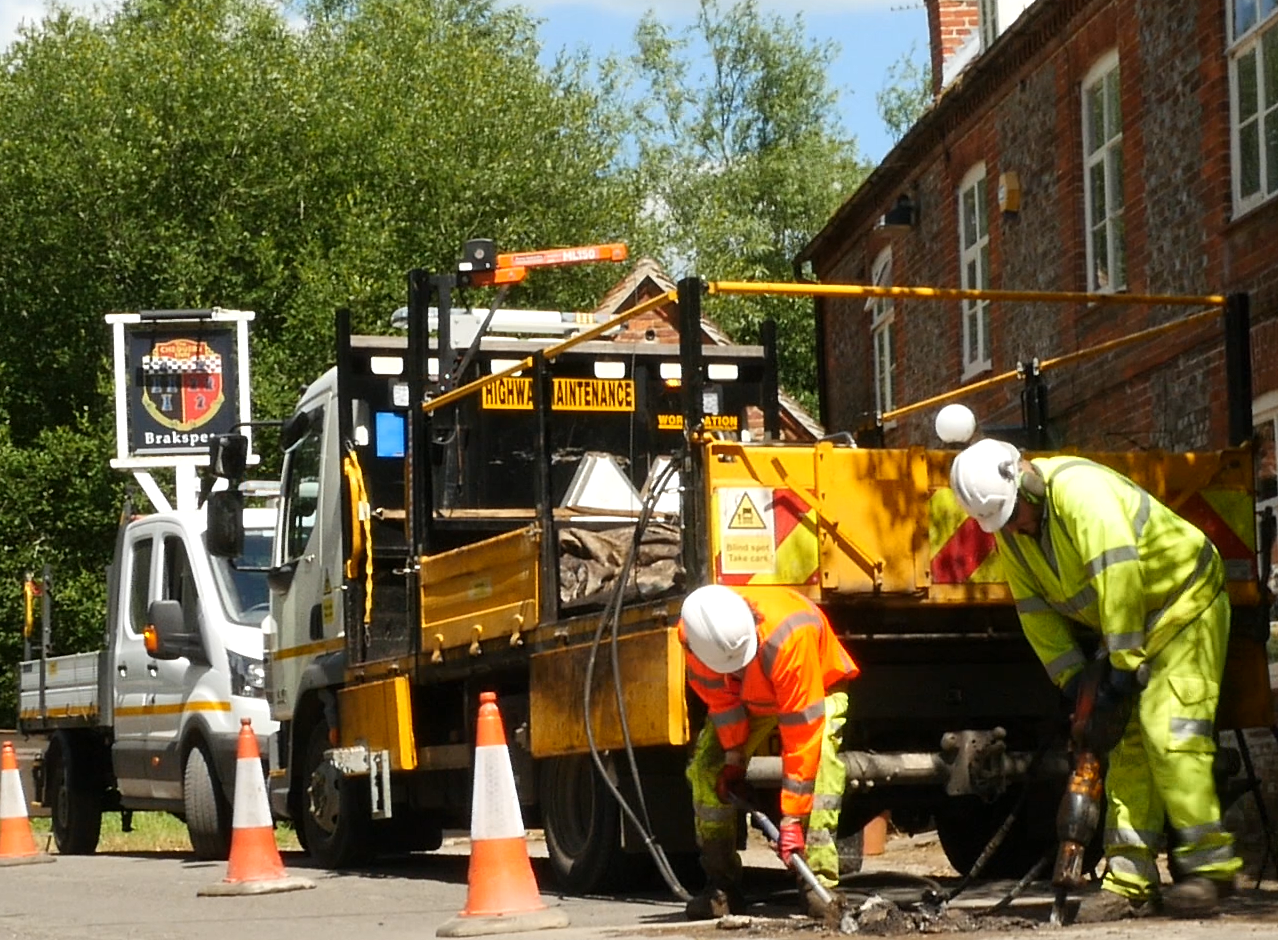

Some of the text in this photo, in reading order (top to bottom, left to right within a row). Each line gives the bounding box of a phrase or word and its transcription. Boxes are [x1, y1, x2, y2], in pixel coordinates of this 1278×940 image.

[486, 379, 632, 407] HIGHWA AINTENANCE
[144, 431, 213, 446] Brakspe
[726, 543, 749, 552] Blind
[728, 554, 746, 562] Take
